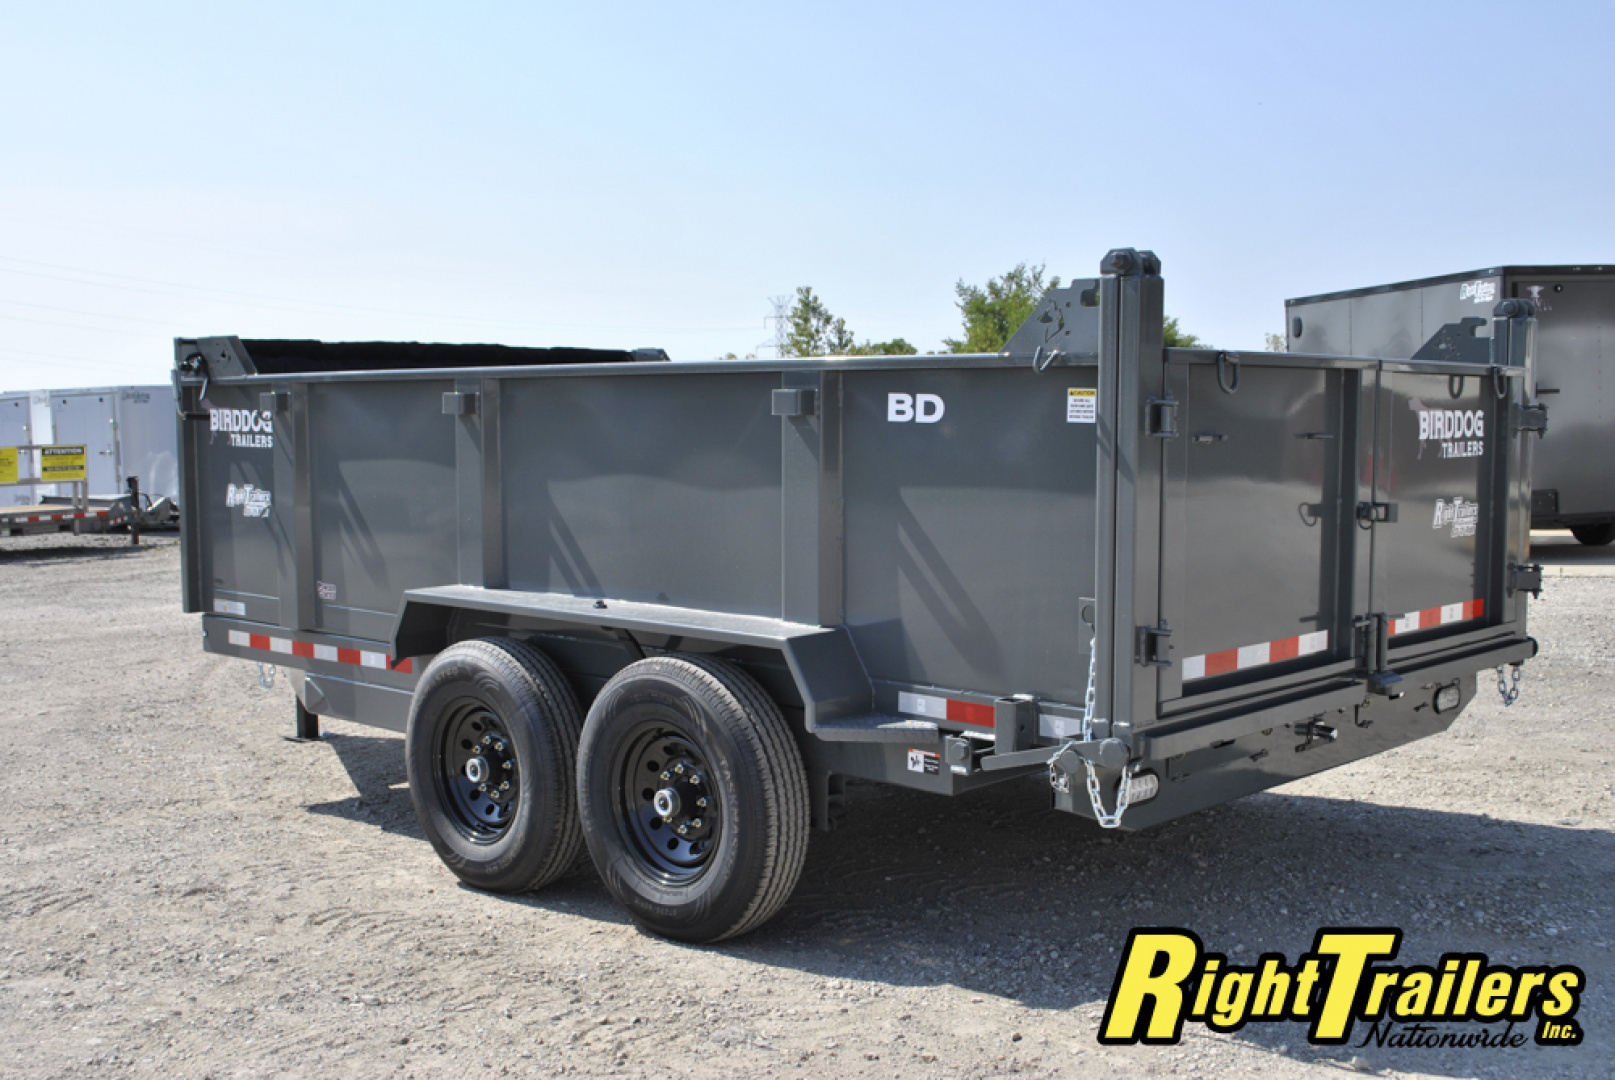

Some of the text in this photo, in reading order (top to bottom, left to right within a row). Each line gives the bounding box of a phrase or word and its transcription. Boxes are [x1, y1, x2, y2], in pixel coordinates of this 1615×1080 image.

[209, 408, 273, 433] BIRDDOG
[887, 393, 945, 423] BD
[1418, 409, 1484, 440] BIRDDOG
[231, 433, 273, 448] TRAILERS
[1441, 440, 1484, 458] TRAILERS
